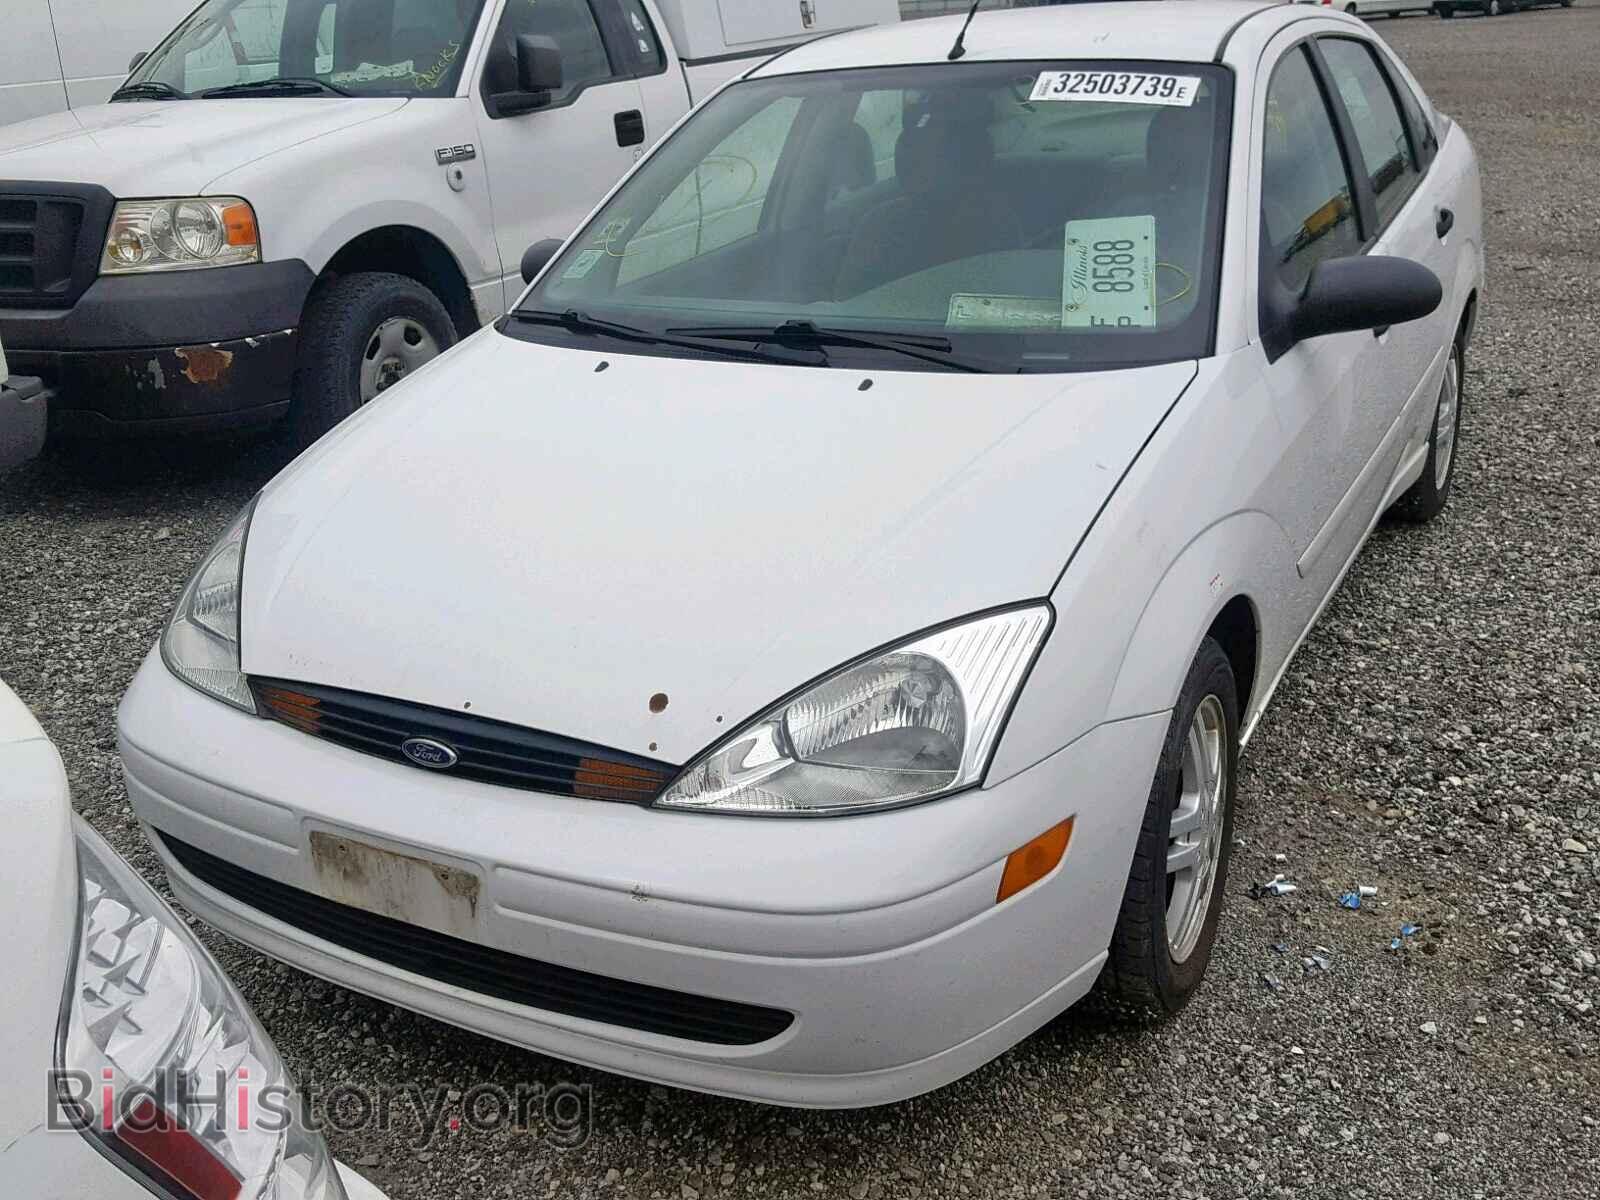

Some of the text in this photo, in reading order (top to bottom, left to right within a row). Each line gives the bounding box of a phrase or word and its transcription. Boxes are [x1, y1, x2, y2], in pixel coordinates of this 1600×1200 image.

[1053, 73, 1178, 98] 32503739
[1070, 244, 1089, 304] Illinois
[1091, 239, 1135, 293] 8588
[414, 743, 442, 761] Ford
